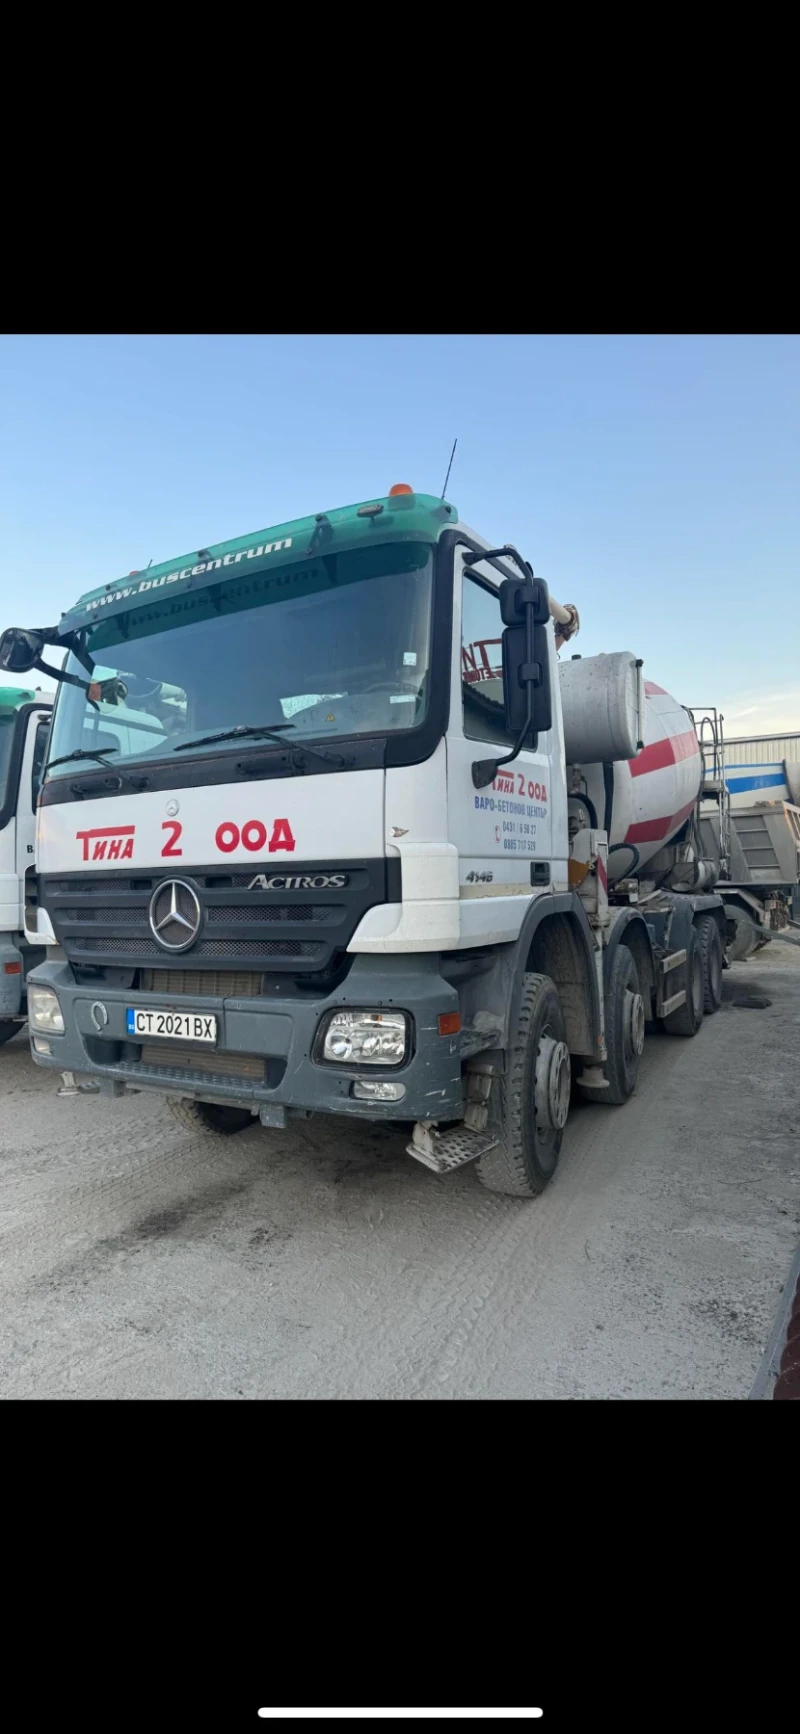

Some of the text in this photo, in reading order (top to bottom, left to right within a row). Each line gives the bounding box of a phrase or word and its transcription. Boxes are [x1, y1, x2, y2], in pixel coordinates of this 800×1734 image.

[85, 537, 293, 612] www.buscentrum
[518, 773, 525, 796] 2
[528, 781, 547, 802] ООД
[161, 821, 182, 857] 2
[215, 818, 295, 853] ООД
[136, 1013, 153, 1032] CT
[157, 1015, 189, 1036] 2021
[194, 1018, 212, 1038] BX
